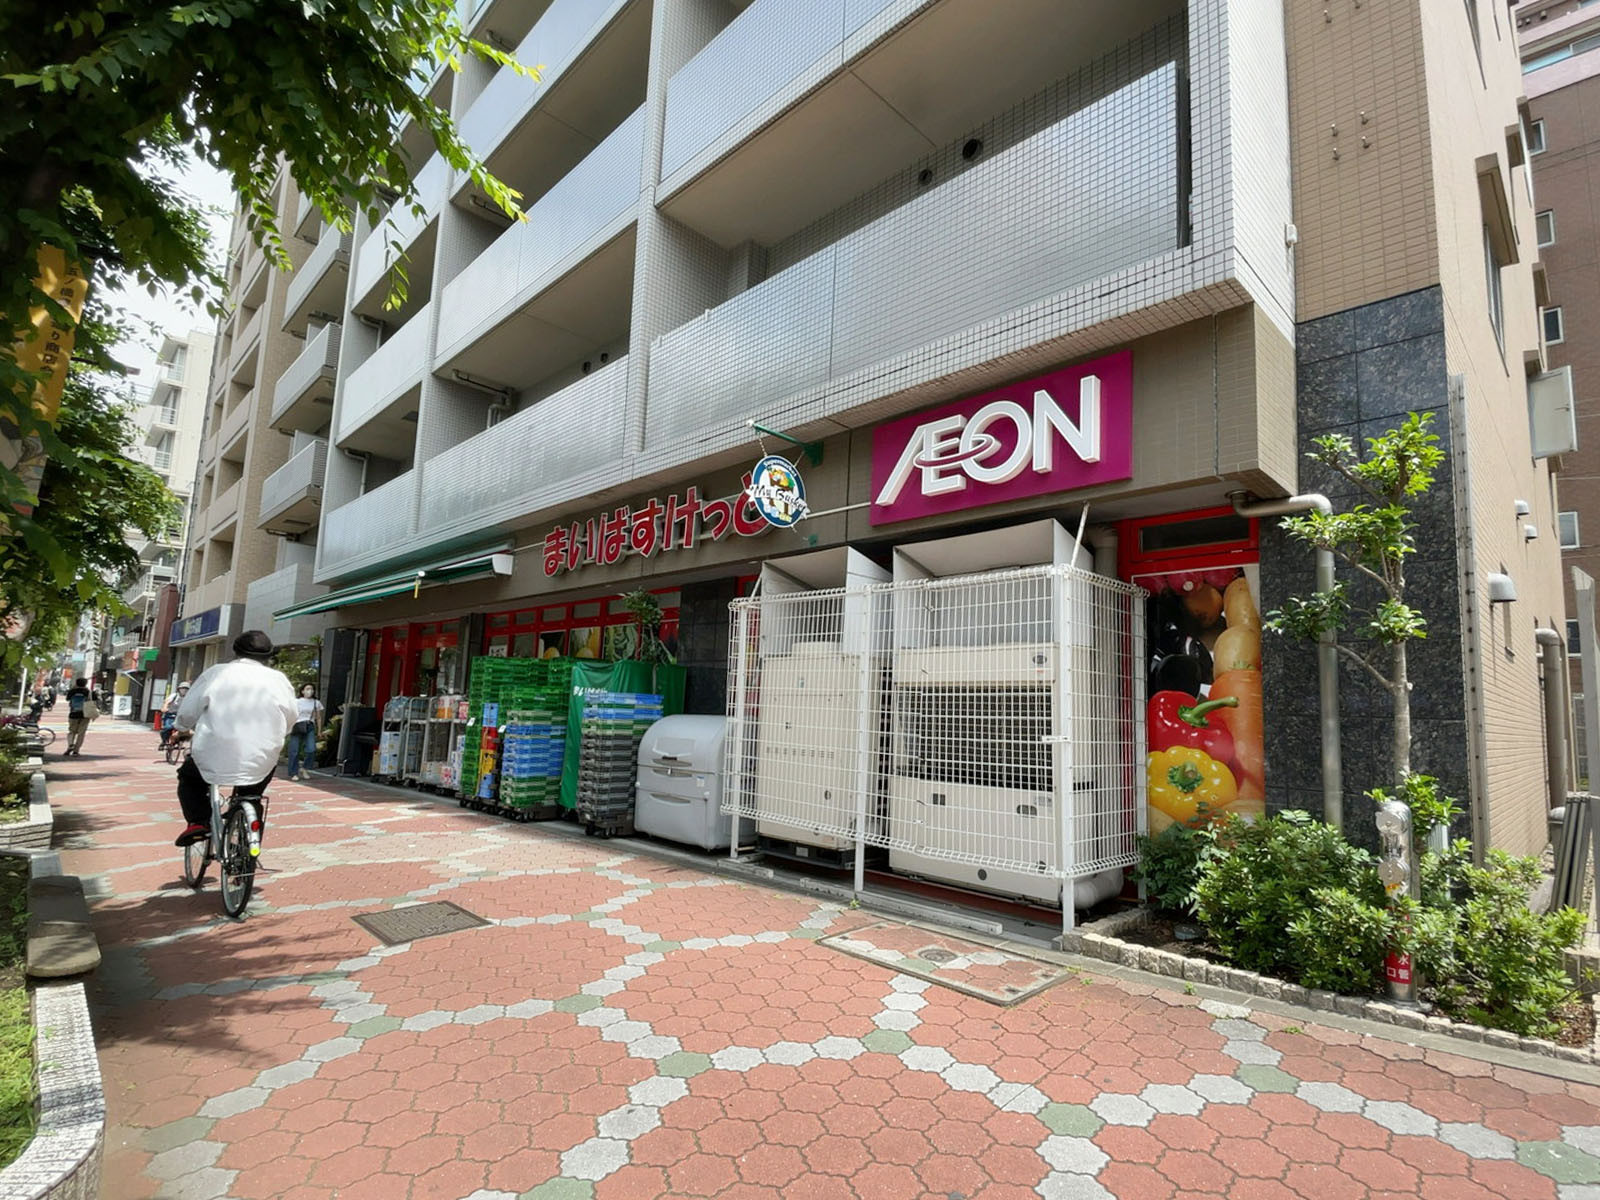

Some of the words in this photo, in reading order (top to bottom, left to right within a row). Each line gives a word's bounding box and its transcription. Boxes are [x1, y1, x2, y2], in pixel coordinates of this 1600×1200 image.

[875, 374, 1102, 507] AEON
[542, 471, 772, 578] まいばすけっと
